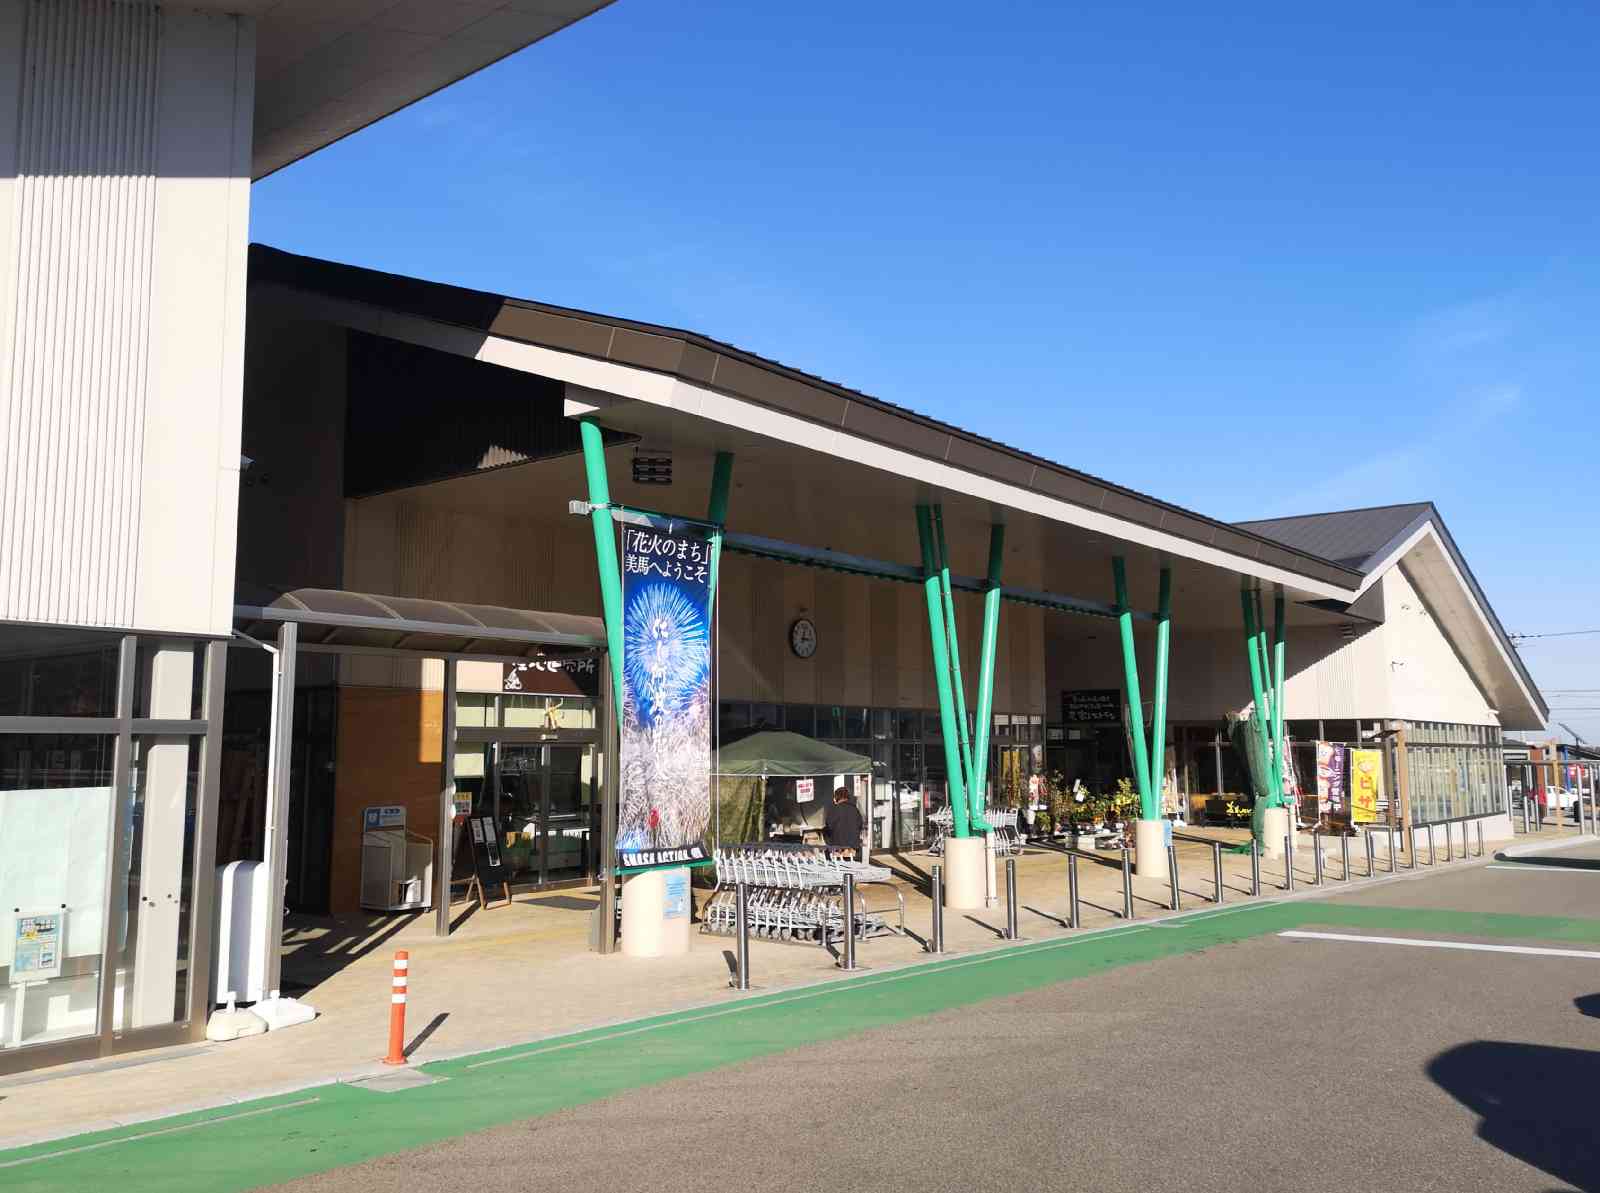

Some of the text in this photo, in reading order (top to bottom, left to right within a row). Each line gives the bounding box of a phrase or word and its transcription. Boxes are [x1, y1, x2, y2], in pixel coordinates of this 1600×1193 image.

[627, 529, 710, 565] 「花火のまち」
[625, 553, 708, 584] 美馬へようこそ
